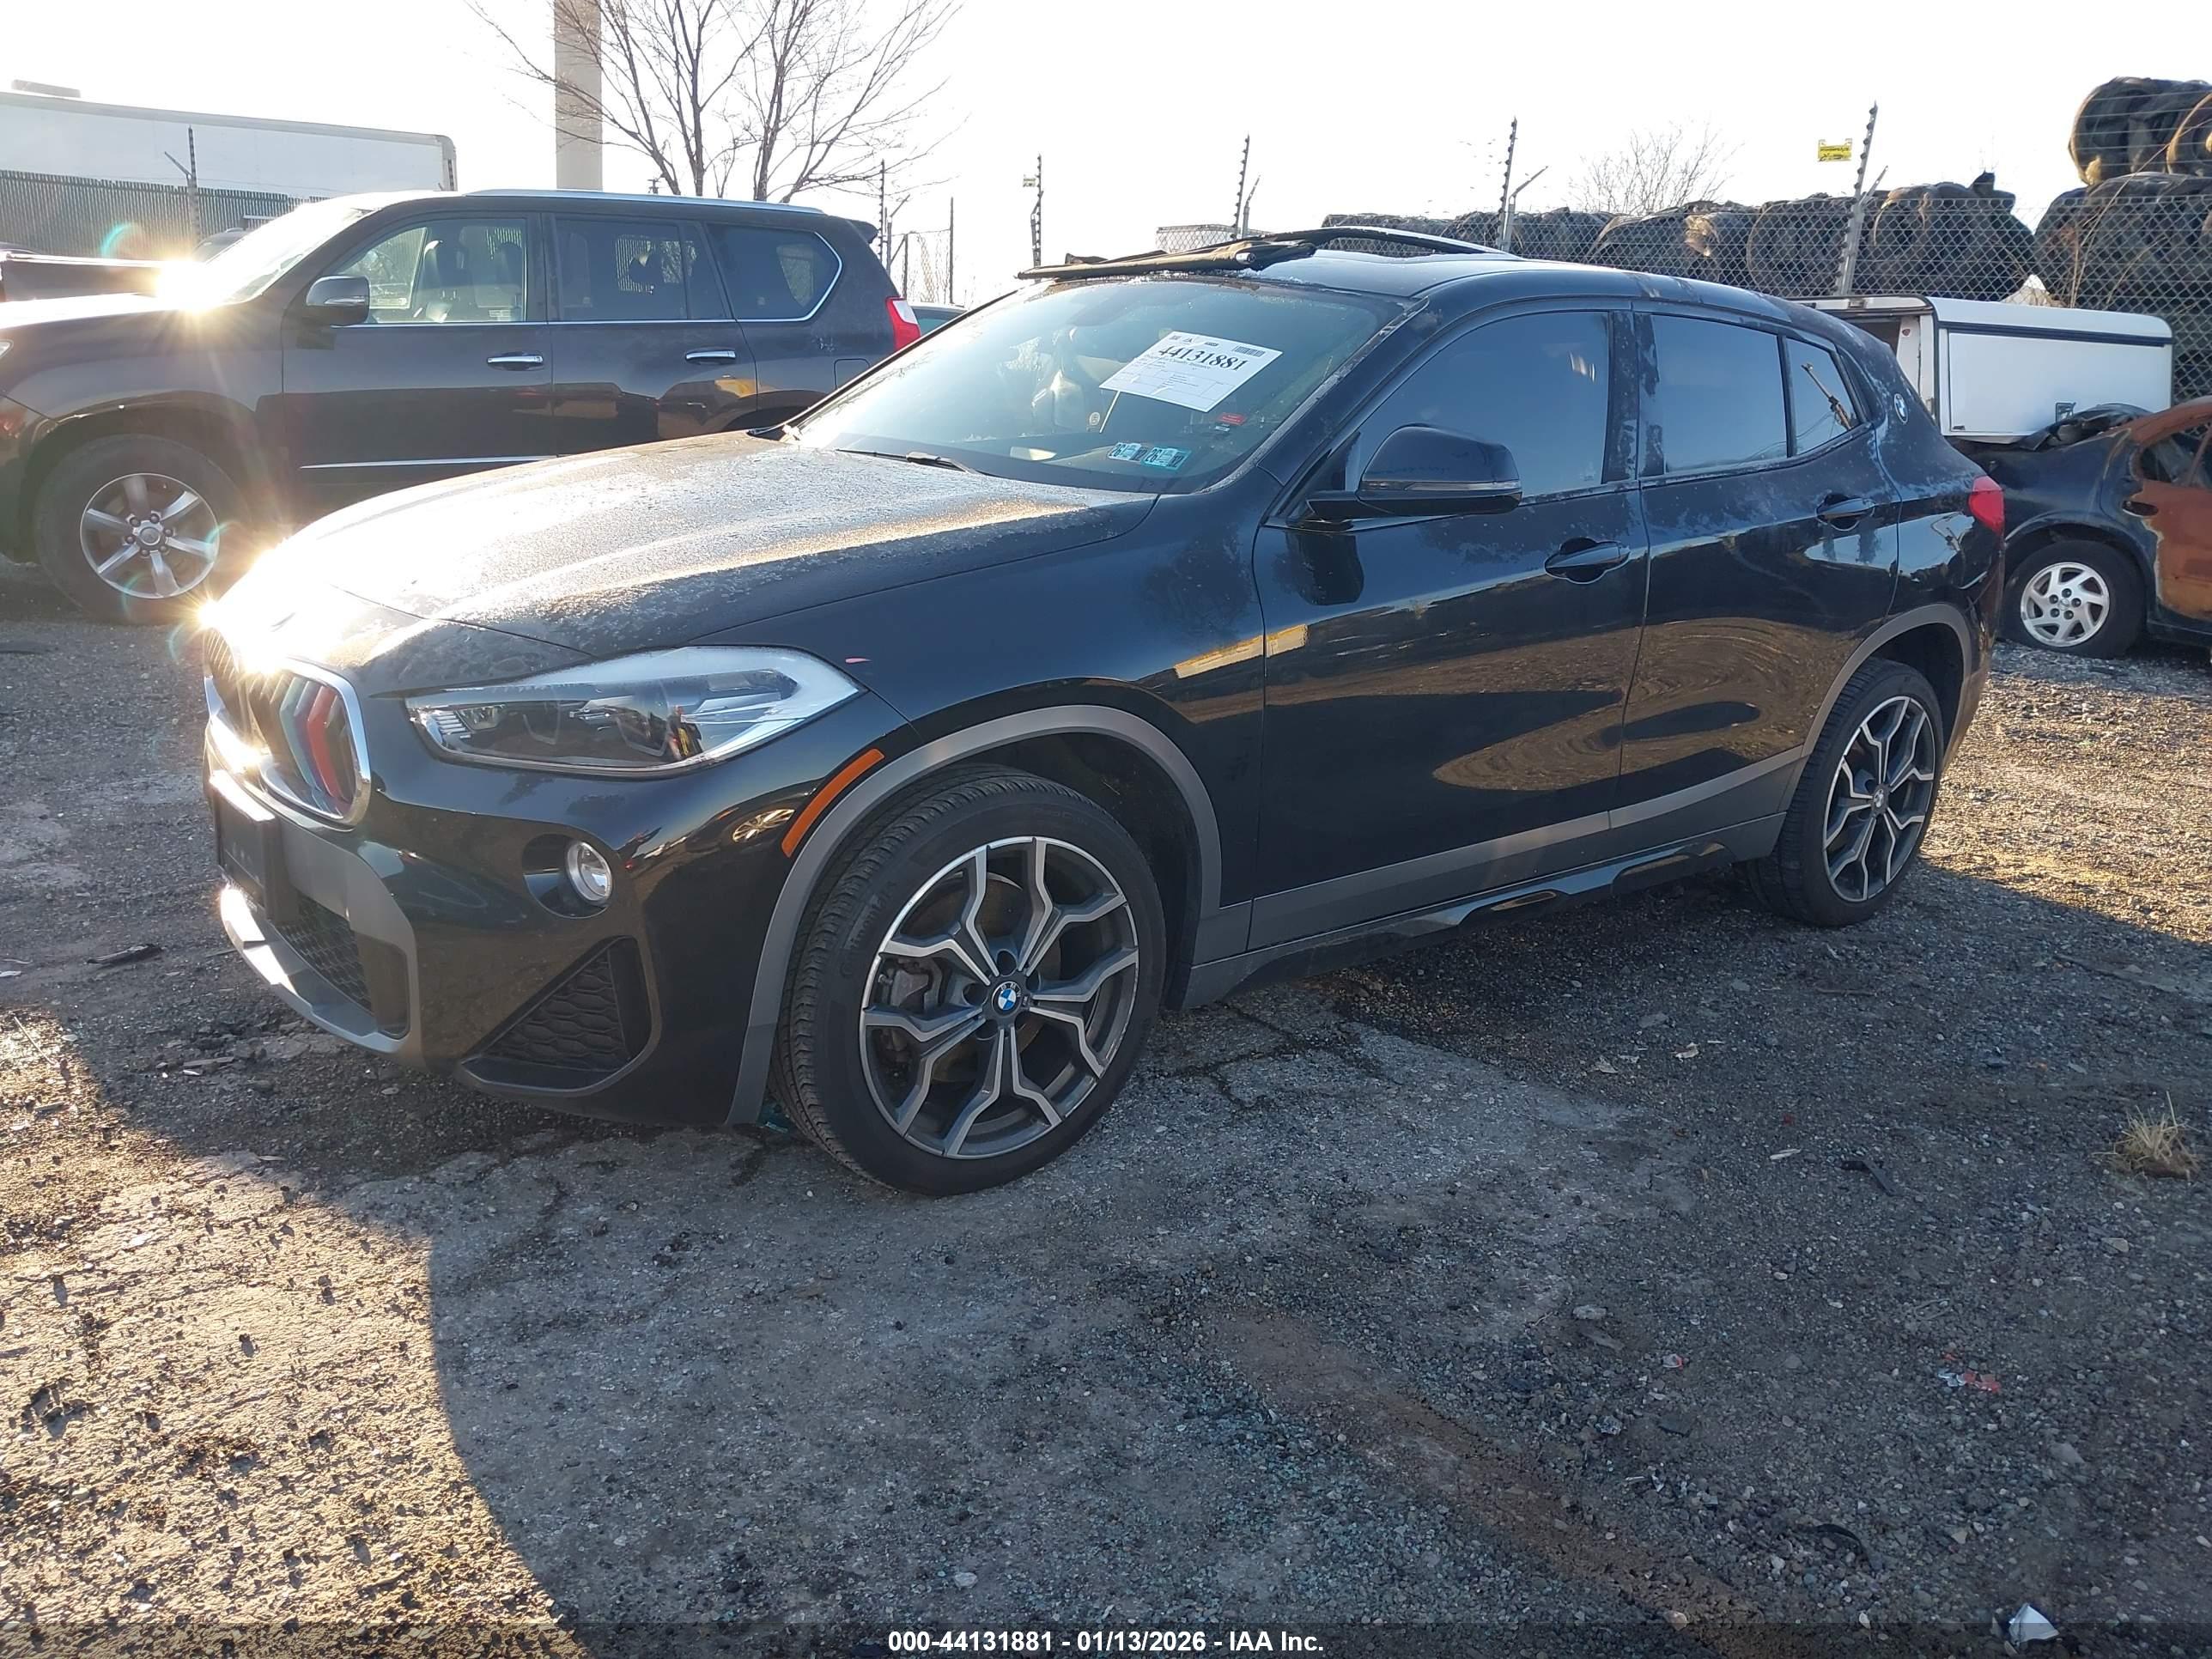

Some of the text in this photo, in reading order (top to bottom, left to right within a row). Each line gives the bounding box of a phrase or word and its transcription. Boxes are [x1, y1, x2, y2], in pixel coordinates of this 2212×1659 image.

[1158, 345, 1249, 371] 44131881
[1109, 444, 1126, 457] 26
[1145, 448, 1163, 463] 26
